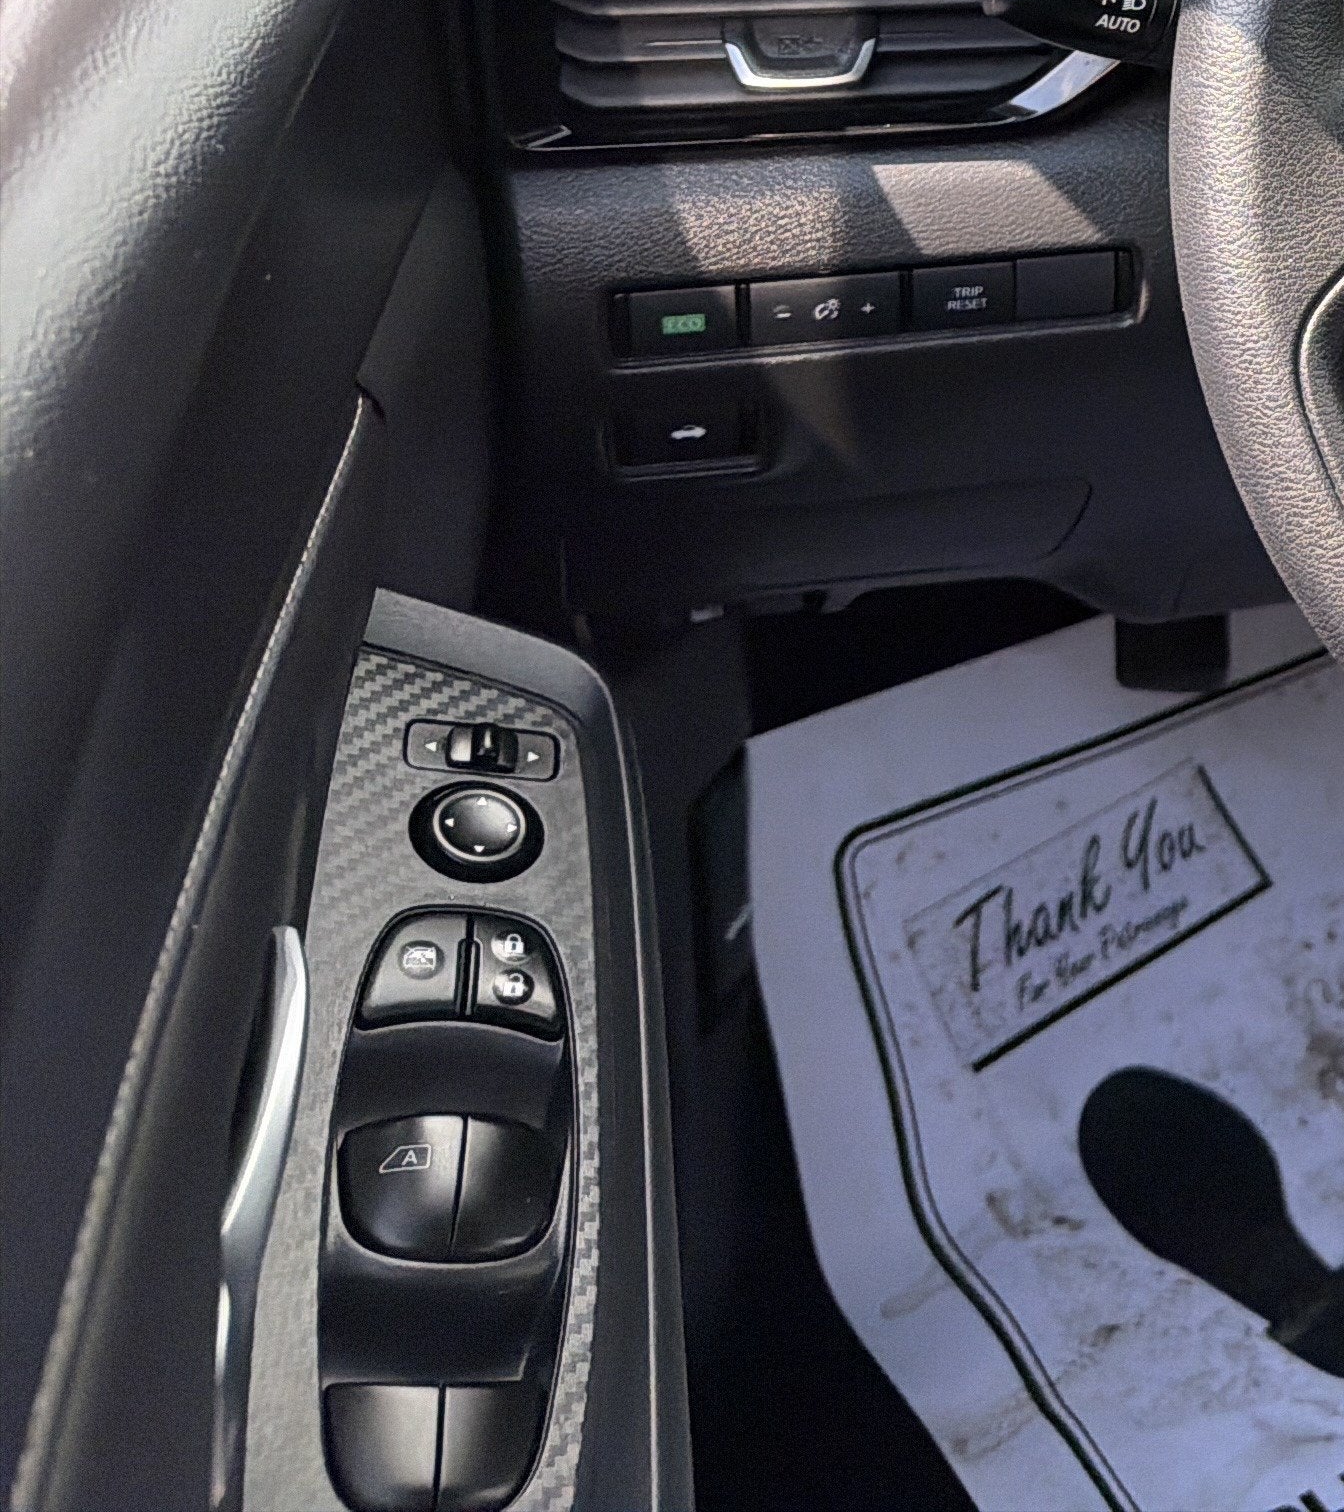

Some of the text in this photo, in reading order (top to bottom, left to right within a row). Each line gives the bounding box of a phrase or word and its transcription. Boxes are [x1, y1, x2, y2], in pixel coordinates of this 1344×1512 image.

[1094, 14, 1141, 34] AUTO
[953, 285, 984, 299] TRIP
[947, 297, 988, 311] RESET
[954, 795, 1206, 993] Thank You
